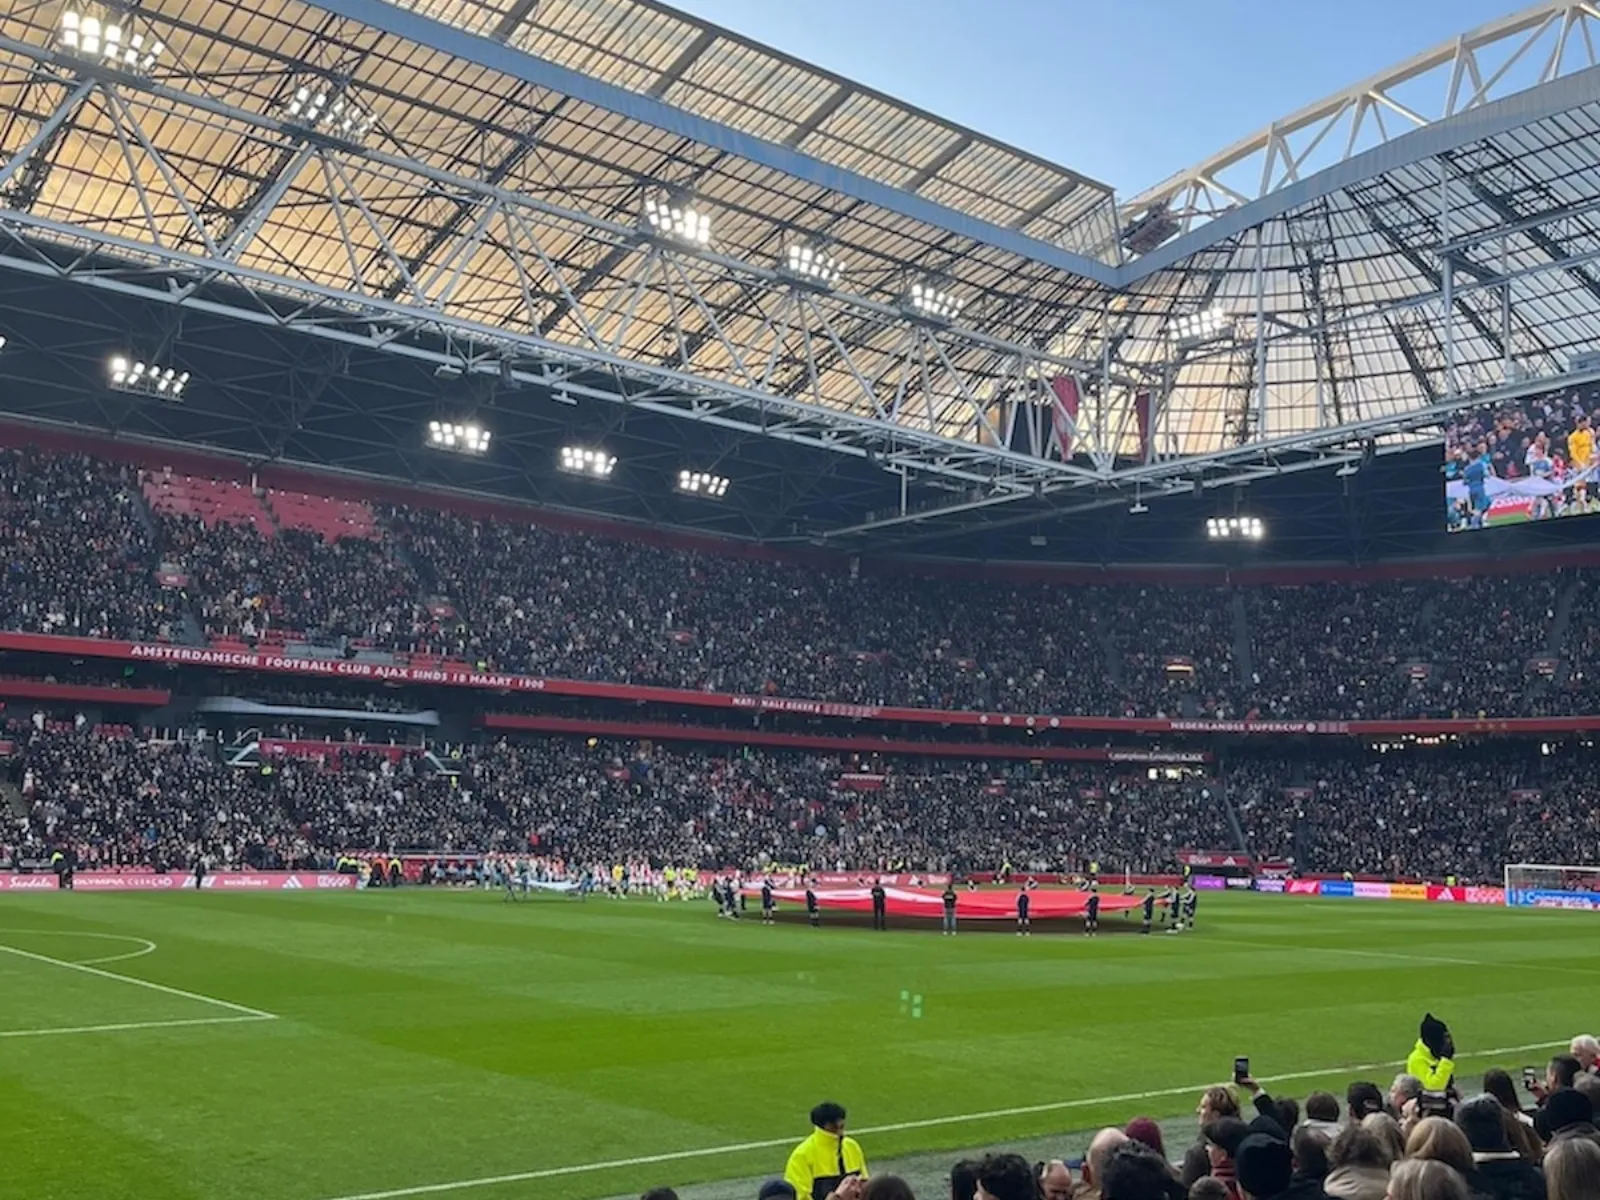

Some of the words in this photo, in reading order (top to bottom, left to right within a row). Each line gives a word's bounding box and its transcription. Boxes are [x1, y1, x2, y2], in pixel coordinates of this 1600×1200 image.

[131, 645, 259, 665] AMSTERDAMSCHE
[265, 656, 333, 672] FOOTBALL
[337, 662, 371, 675] CLUB
[374, 665, 408, 679] AJAX
[412, 669, 448, 682] SINDS
[469, 674, 513, 687] MAART
[1170, 721, 1245, 731] NEDERLANDSE
[1248, 721, 1304, 732] SUPERCUP
